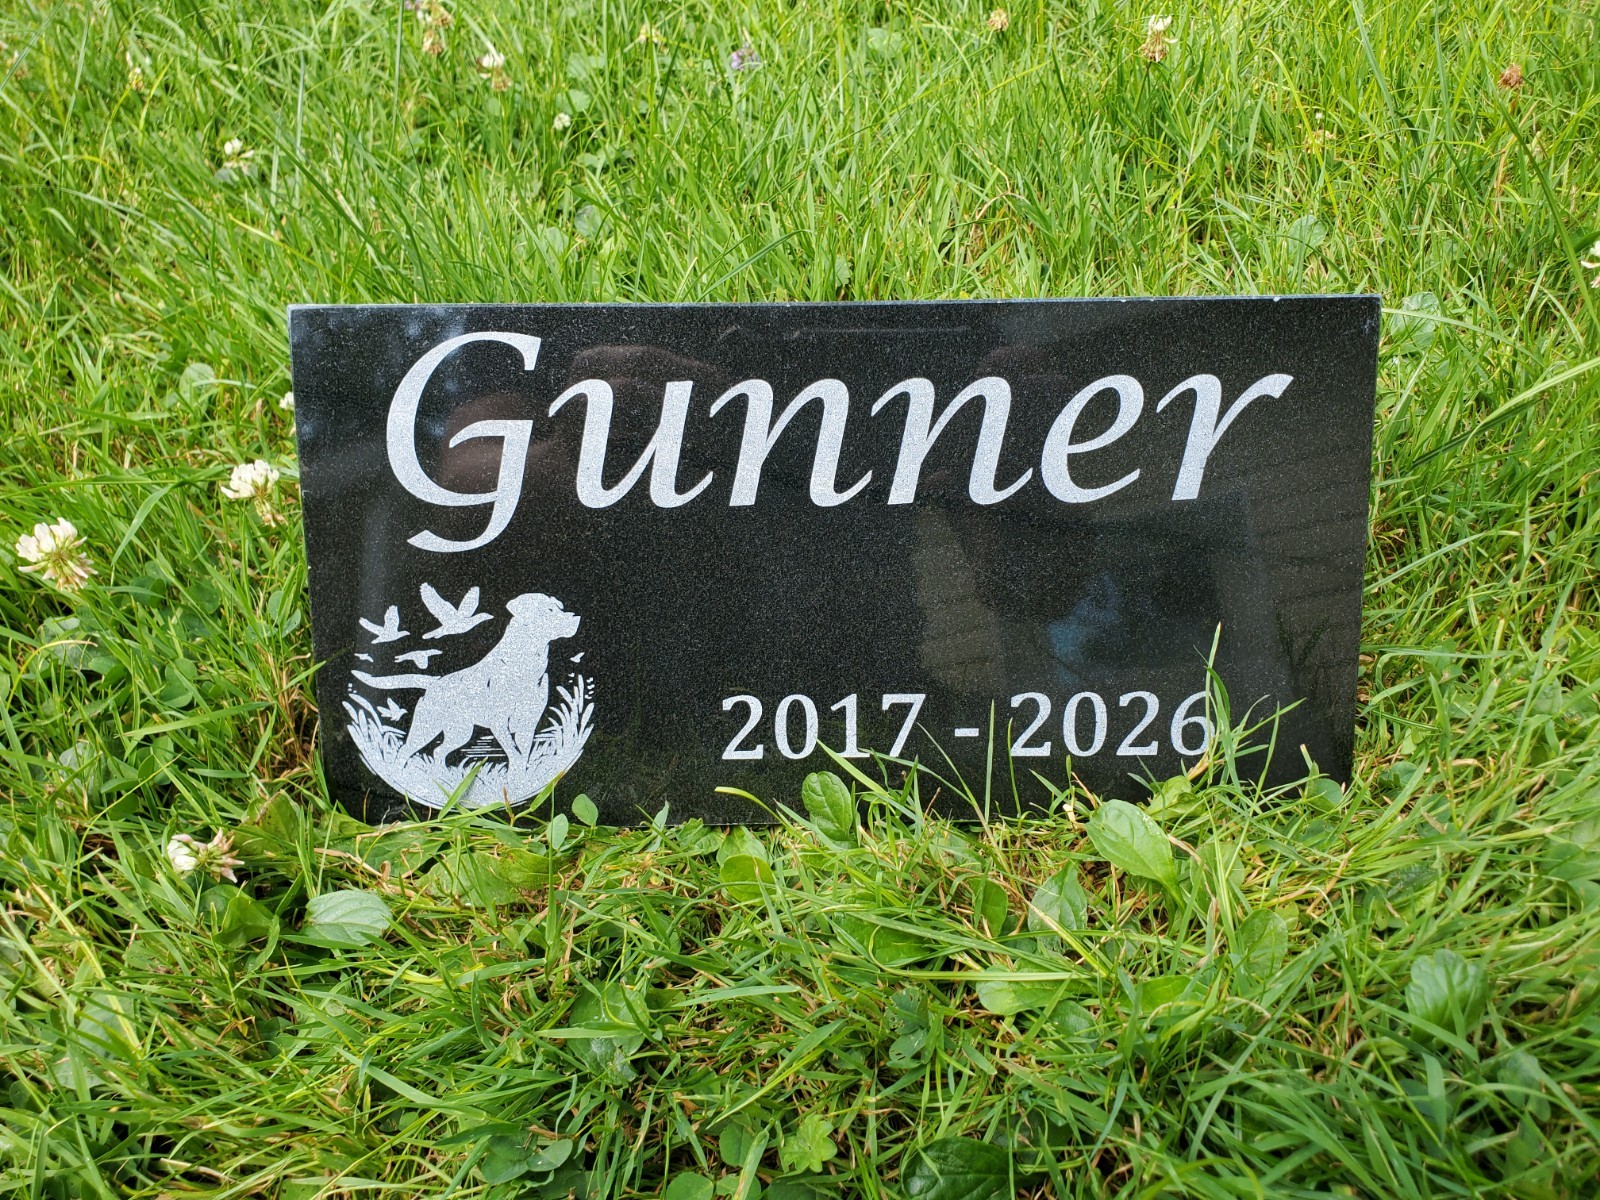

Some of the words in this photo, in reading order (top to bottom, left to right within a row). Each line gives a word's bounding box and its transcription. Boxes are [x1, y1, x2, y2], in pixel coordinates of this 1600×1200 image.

[386, 330, 1294, 553] Gunner
[721, 692, 926, 760] 2017
[953, 726, 980, 738] -
[1009, 690, 1217, 757] 2026
